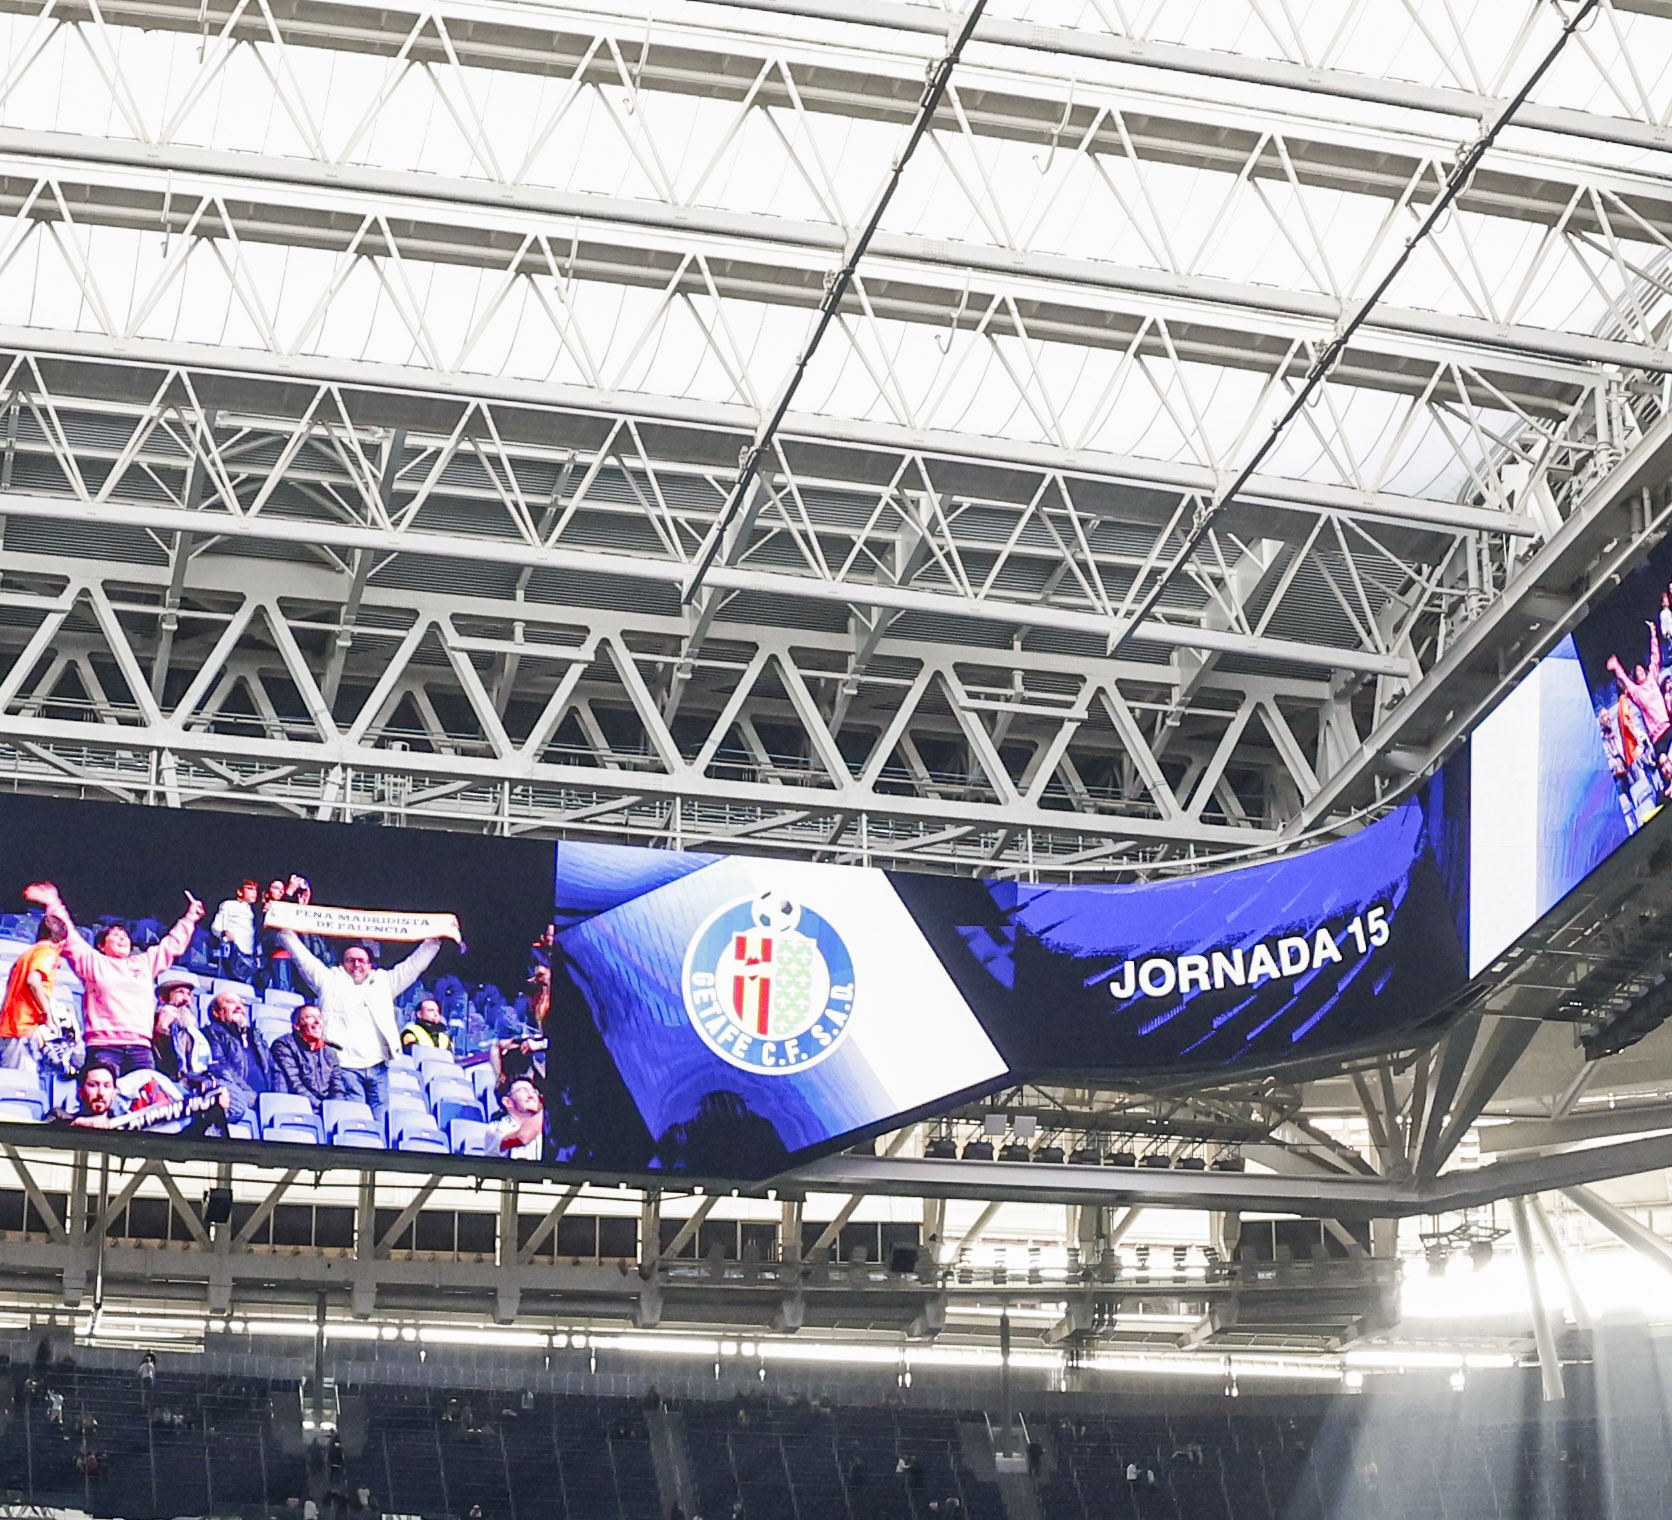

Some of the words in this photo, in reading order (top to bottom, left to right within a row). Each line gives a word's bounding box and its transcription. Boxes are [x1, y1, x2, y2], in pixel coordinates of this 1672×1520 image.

[316, 921, 334, 929] DE
[338, 914, 430, 926] MADRIDISTA
[1109, 927, 1342, 999] JORNADA
[1347, 906, 1390, 953] 15
[691, 971, 753, 1059] GETAFE
[762, 1039, 809, 1067] C.F.
